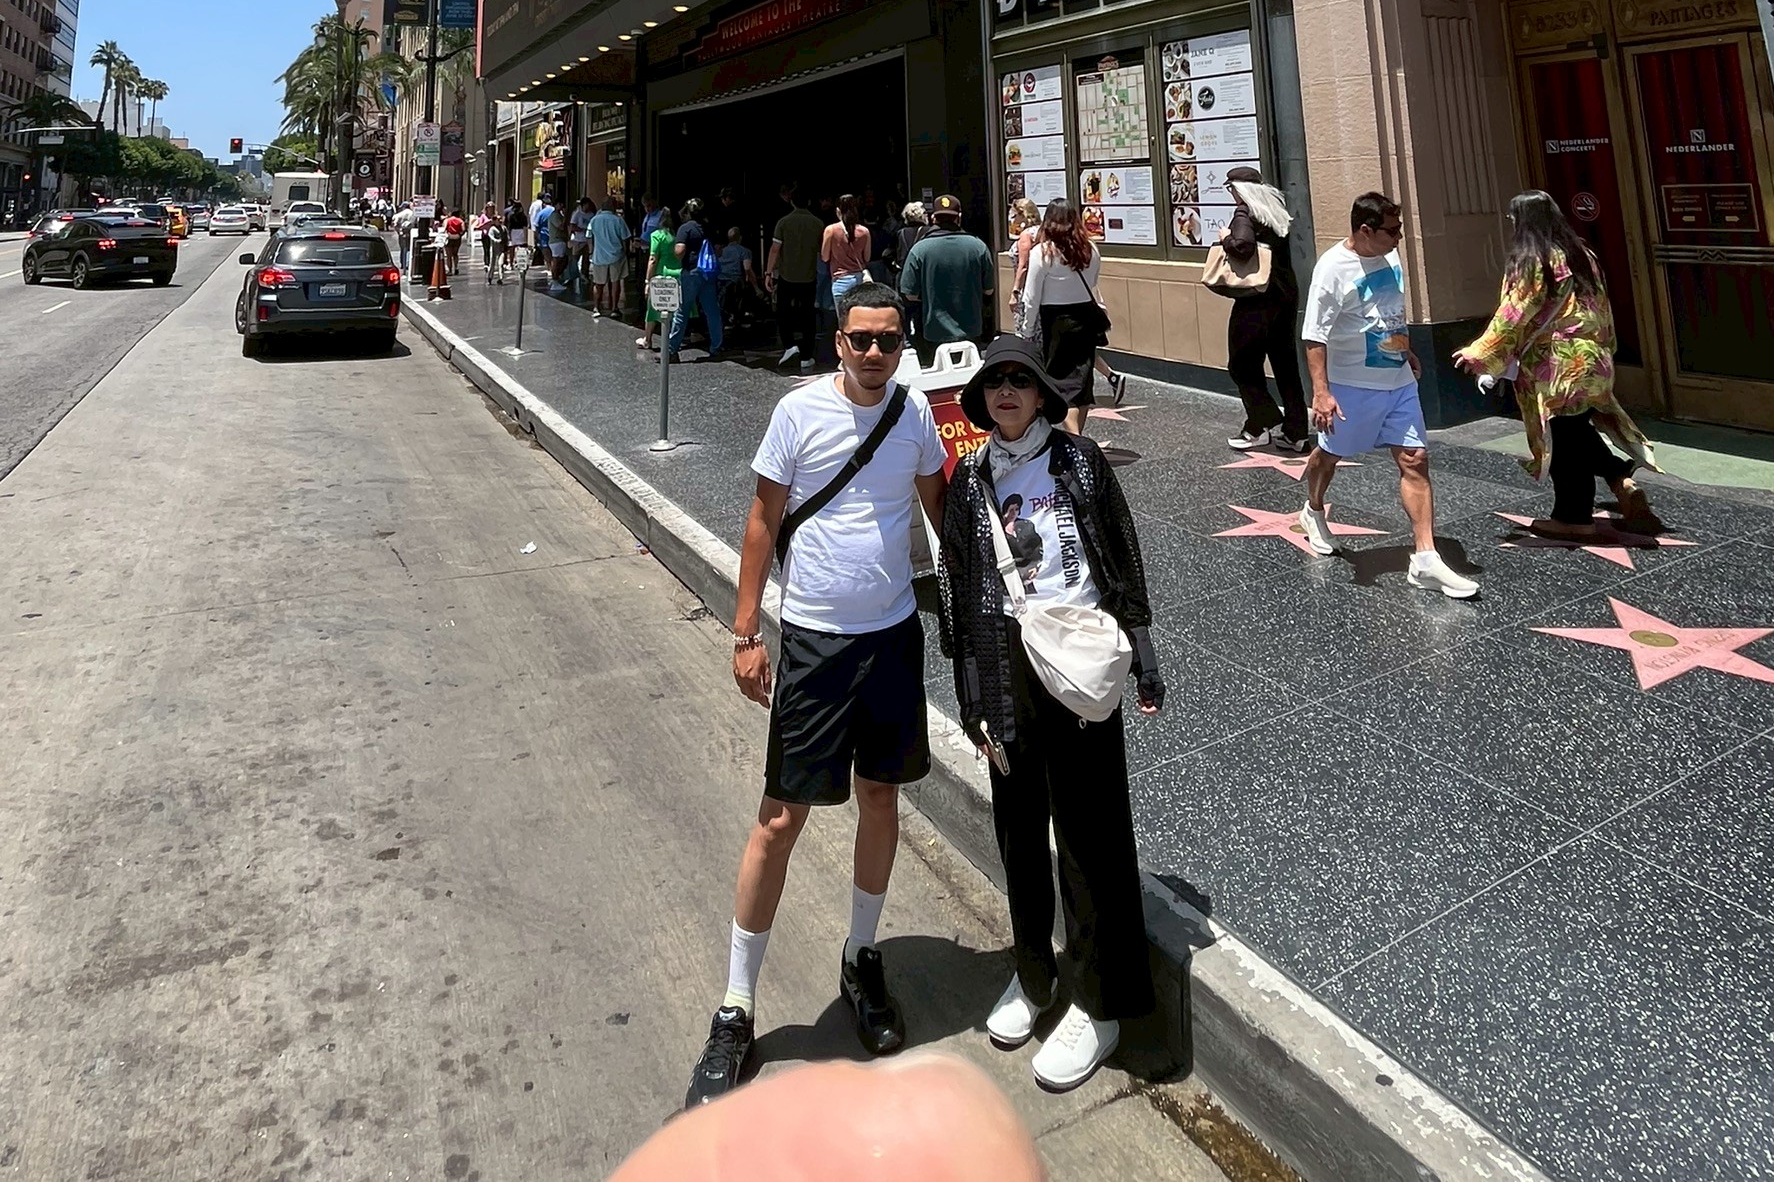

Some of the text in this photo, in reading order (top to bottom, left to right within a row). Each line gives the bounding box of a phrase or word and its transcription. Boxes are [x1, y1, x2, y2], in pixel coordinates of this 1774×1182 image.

[721, 14, 764, 40] WELCOME
[767, 3, 780, 23] TO
[1560, 138, 1609, 146] NEDERLANDER
[1560, 145, 1596, 153] CONCERTS
[1665, 143, 1736, 154] NEDERLANDER
[1204, 218, 1225, 230] TAO
[955, 435, 991, 458] ENT
[1059, 530, 1082, 589] JACKSON
